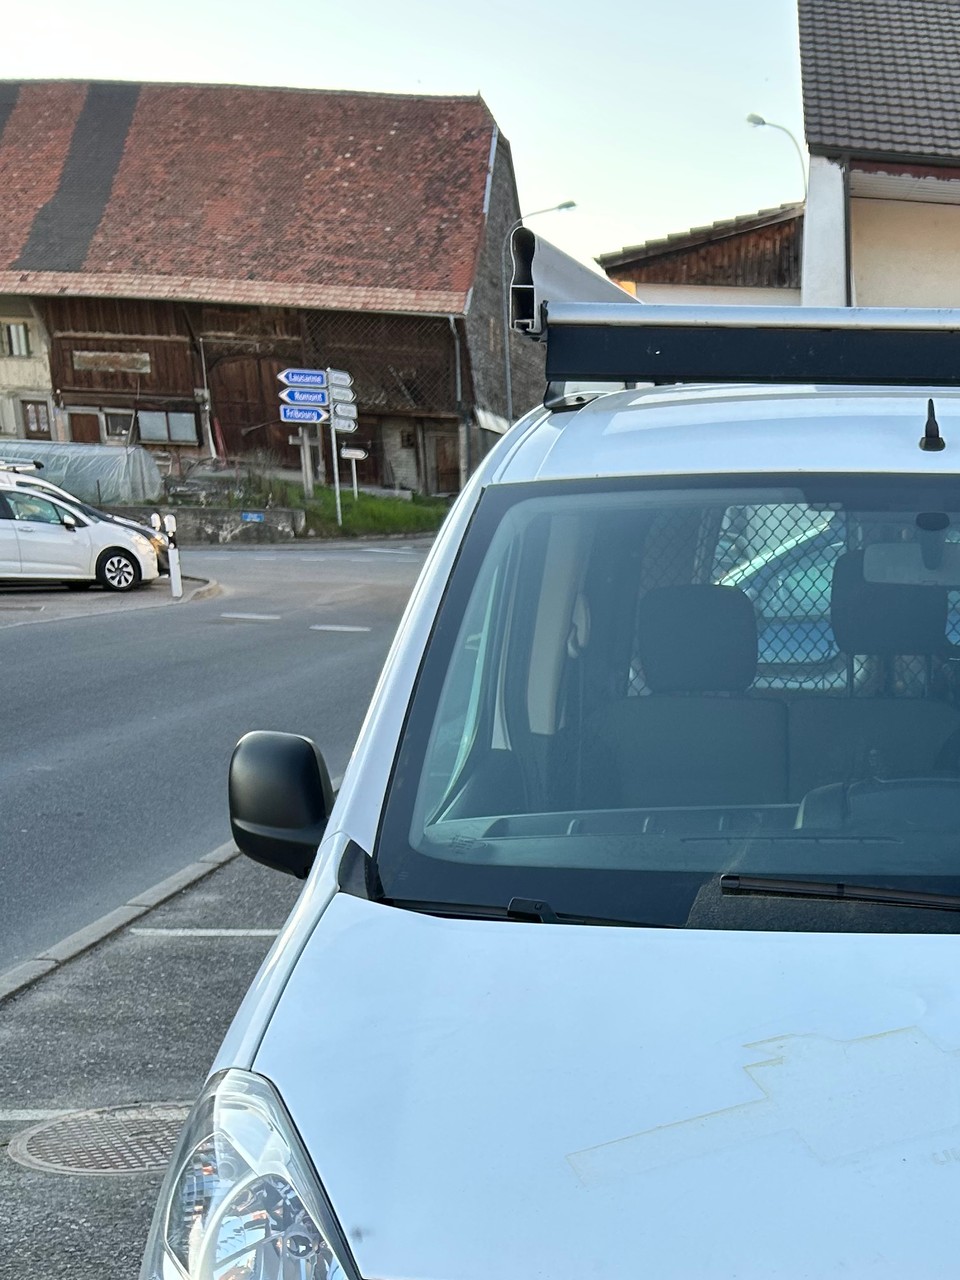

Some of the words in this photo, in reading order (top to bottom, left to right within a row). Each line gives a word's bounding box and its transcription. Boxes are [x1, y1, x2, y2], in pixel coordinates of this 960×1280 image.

[288, 373, 323, 384] Lausanne
[294, 391, 323, 402] Romont
[285, 408, 318, 420] Fribourg
